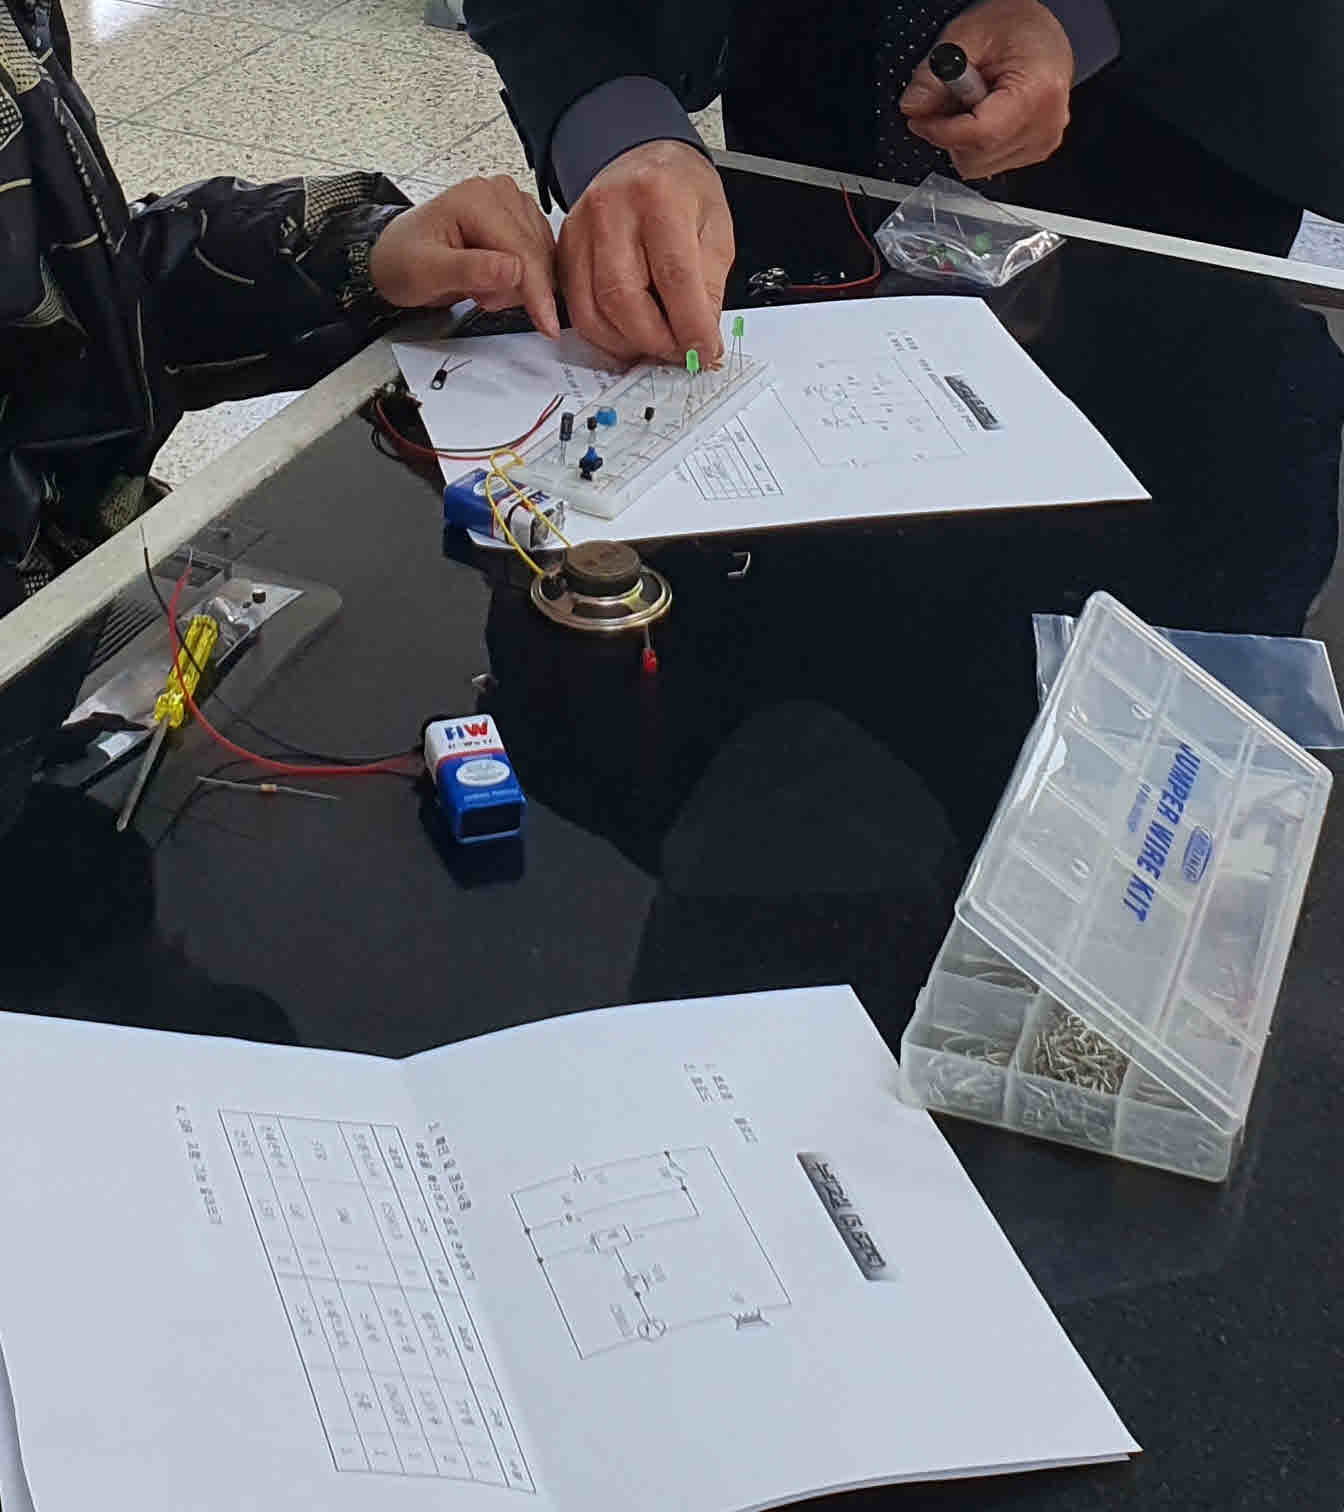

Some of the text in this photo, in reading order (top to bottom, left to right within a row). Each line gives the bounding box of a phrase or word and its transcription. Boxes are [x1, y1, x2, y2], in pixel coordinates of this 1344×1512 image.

[1157, 742, 1201, 825] JUMPER
[1136, 820, 1175, 881] WIRE
[1123, 874, 1155, 923] KIT
